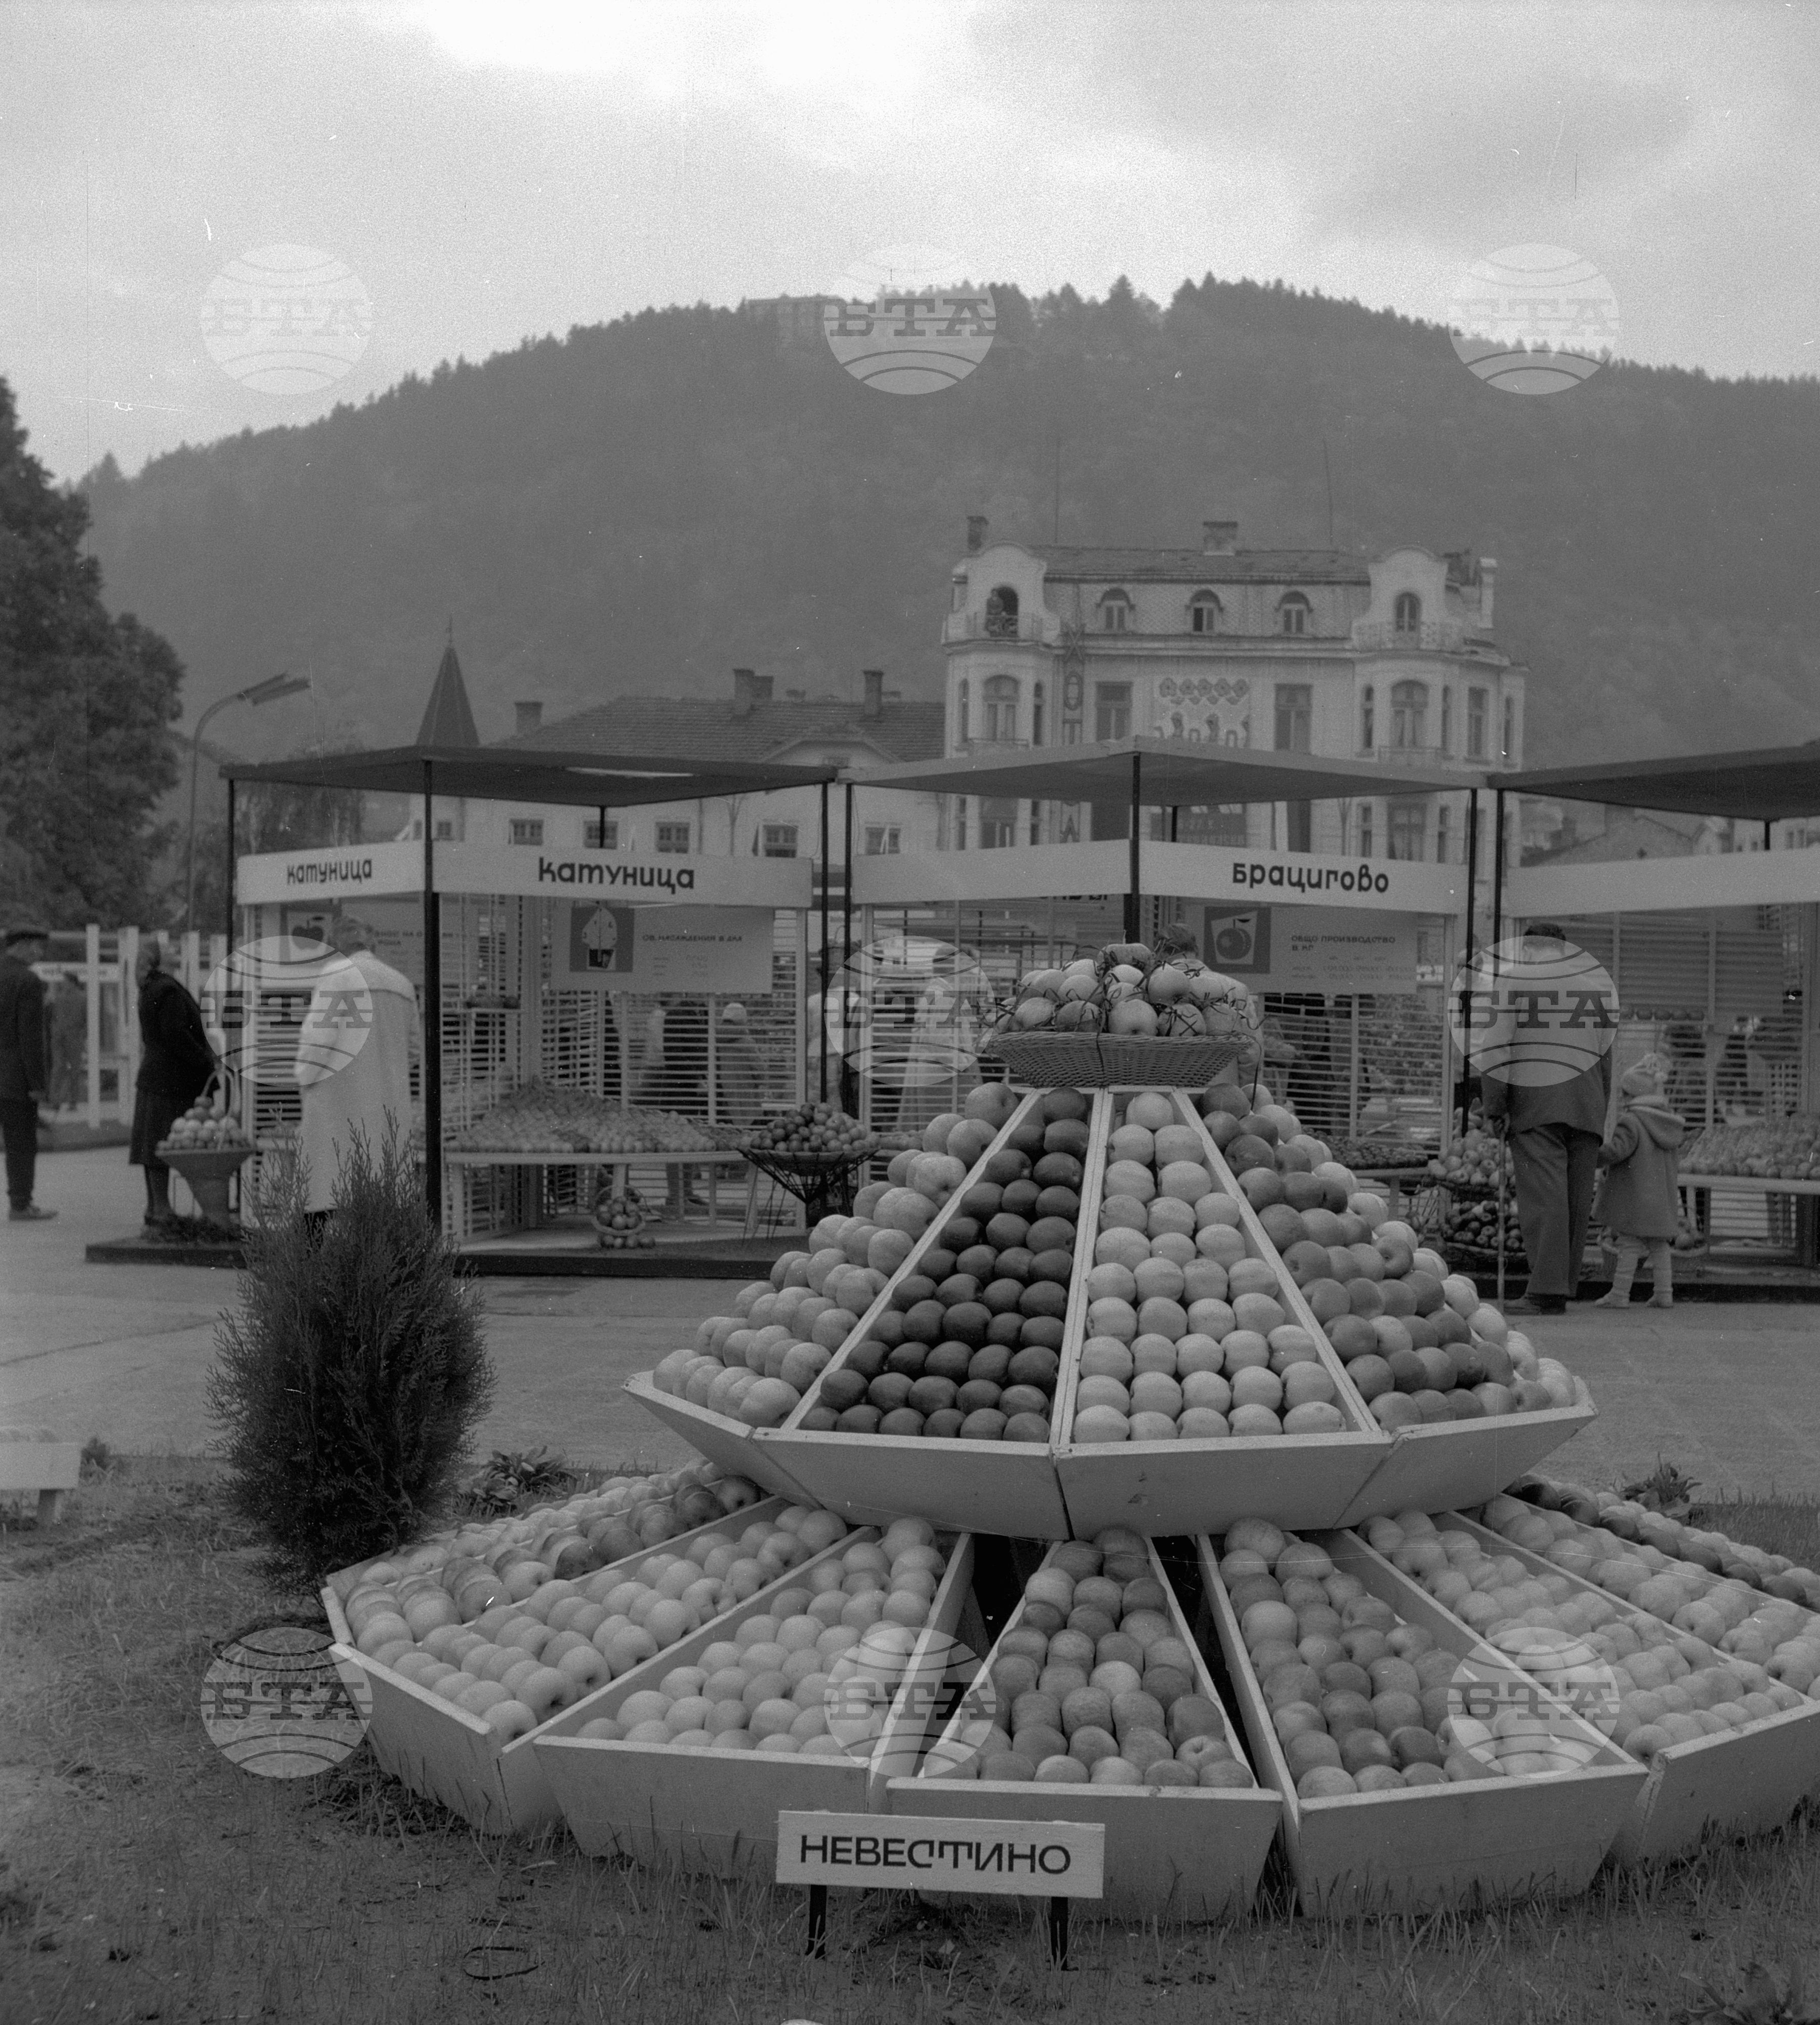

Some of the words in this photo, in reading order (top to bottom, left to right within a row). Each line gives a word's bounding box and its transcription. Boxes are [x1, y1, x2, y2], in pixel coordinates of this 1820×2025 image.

[287, 859, 373, 884] катуница
[539, 857, 694, 895] катуница
[1232, 862, 1389, 894] Брацигово
[1321, 936, 1395, 944] ПРОИЗВОДСТВО
[800, 1835, 1071, 1874] НЕВЕСТИНО
